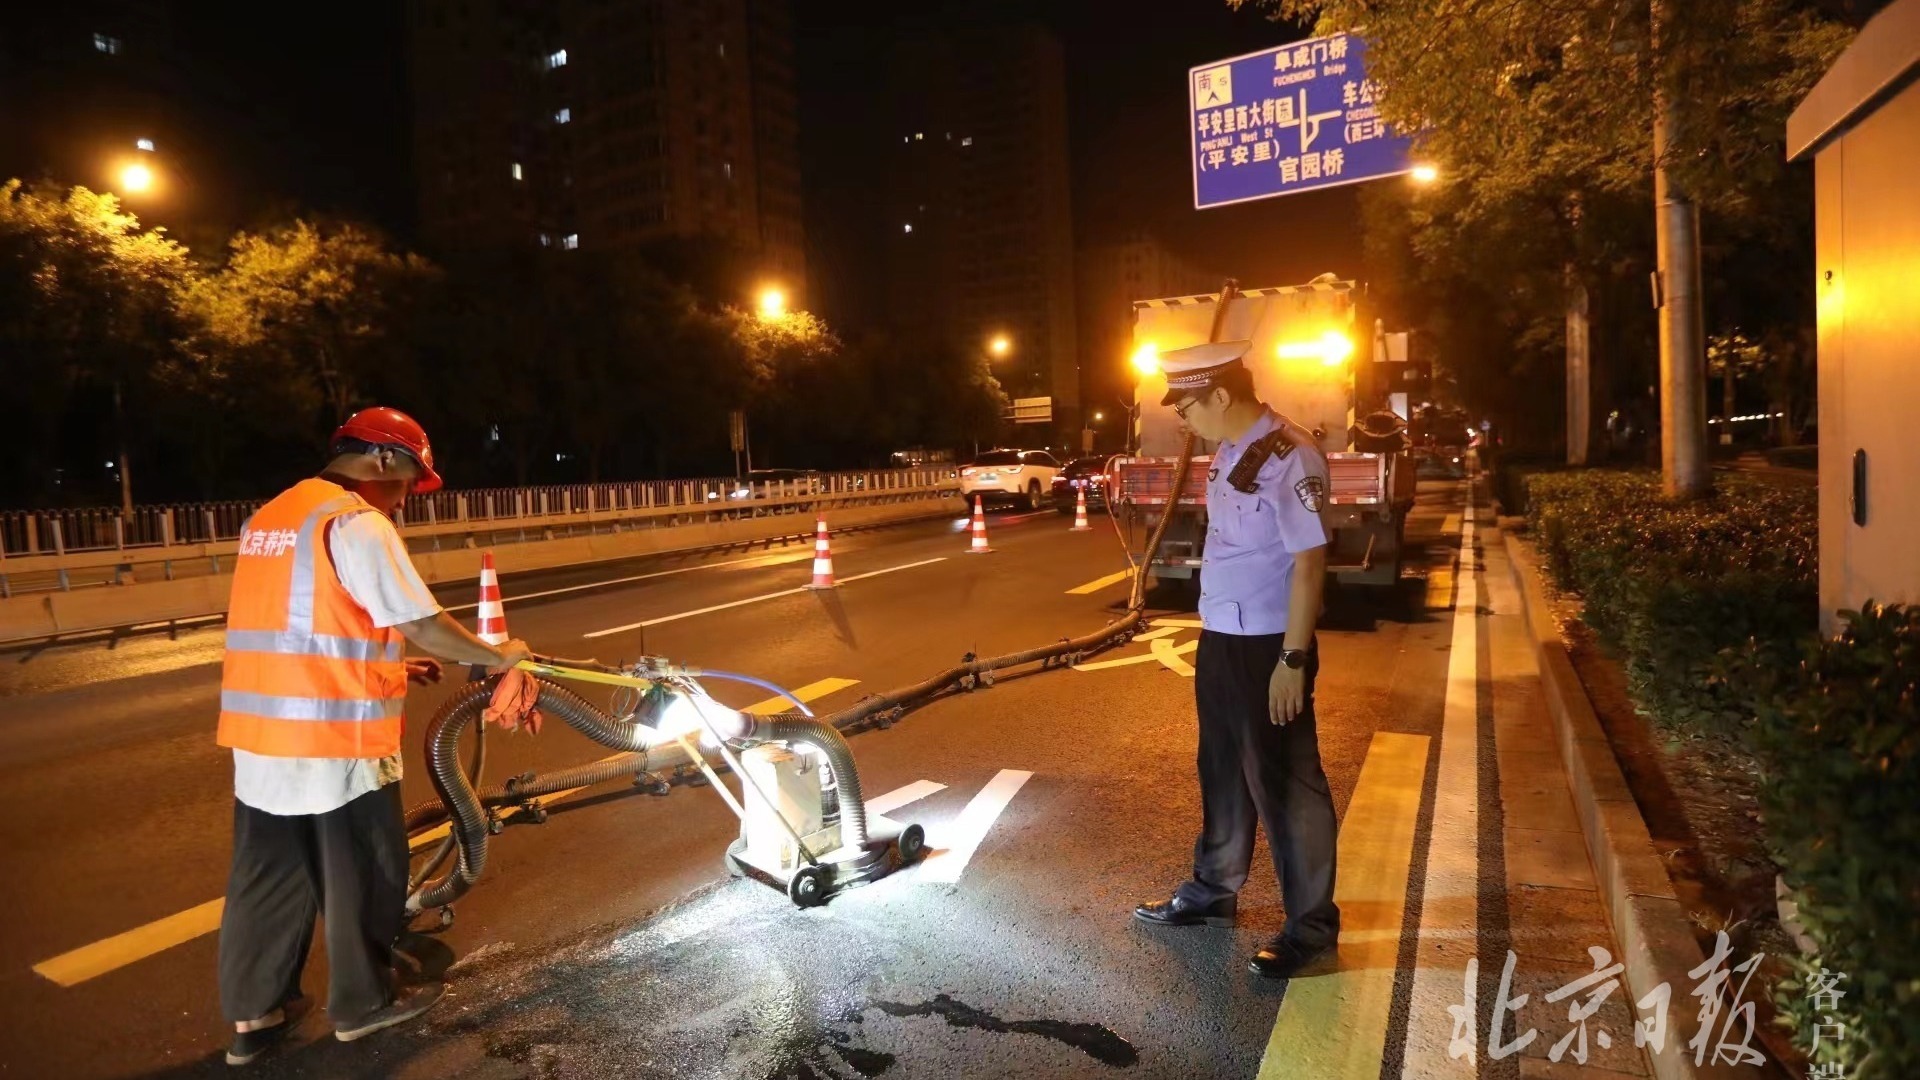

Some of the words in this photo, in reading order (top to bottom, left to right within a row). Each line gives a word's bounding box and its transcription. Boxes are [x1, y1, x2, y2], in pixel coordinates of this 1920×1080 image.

[1274, 36, 1348, 72] 阜成门桥
[1198, 73, 1211, 91] 南
[1219, 76, 1228, 86] S
[1198, 98, 1275, 138] 平安里西大街
[1241, 130, 1258, 143] West
[1279, 147, 1344, 184] 官园桥
[238, 528, 298, 557] 北京养护
